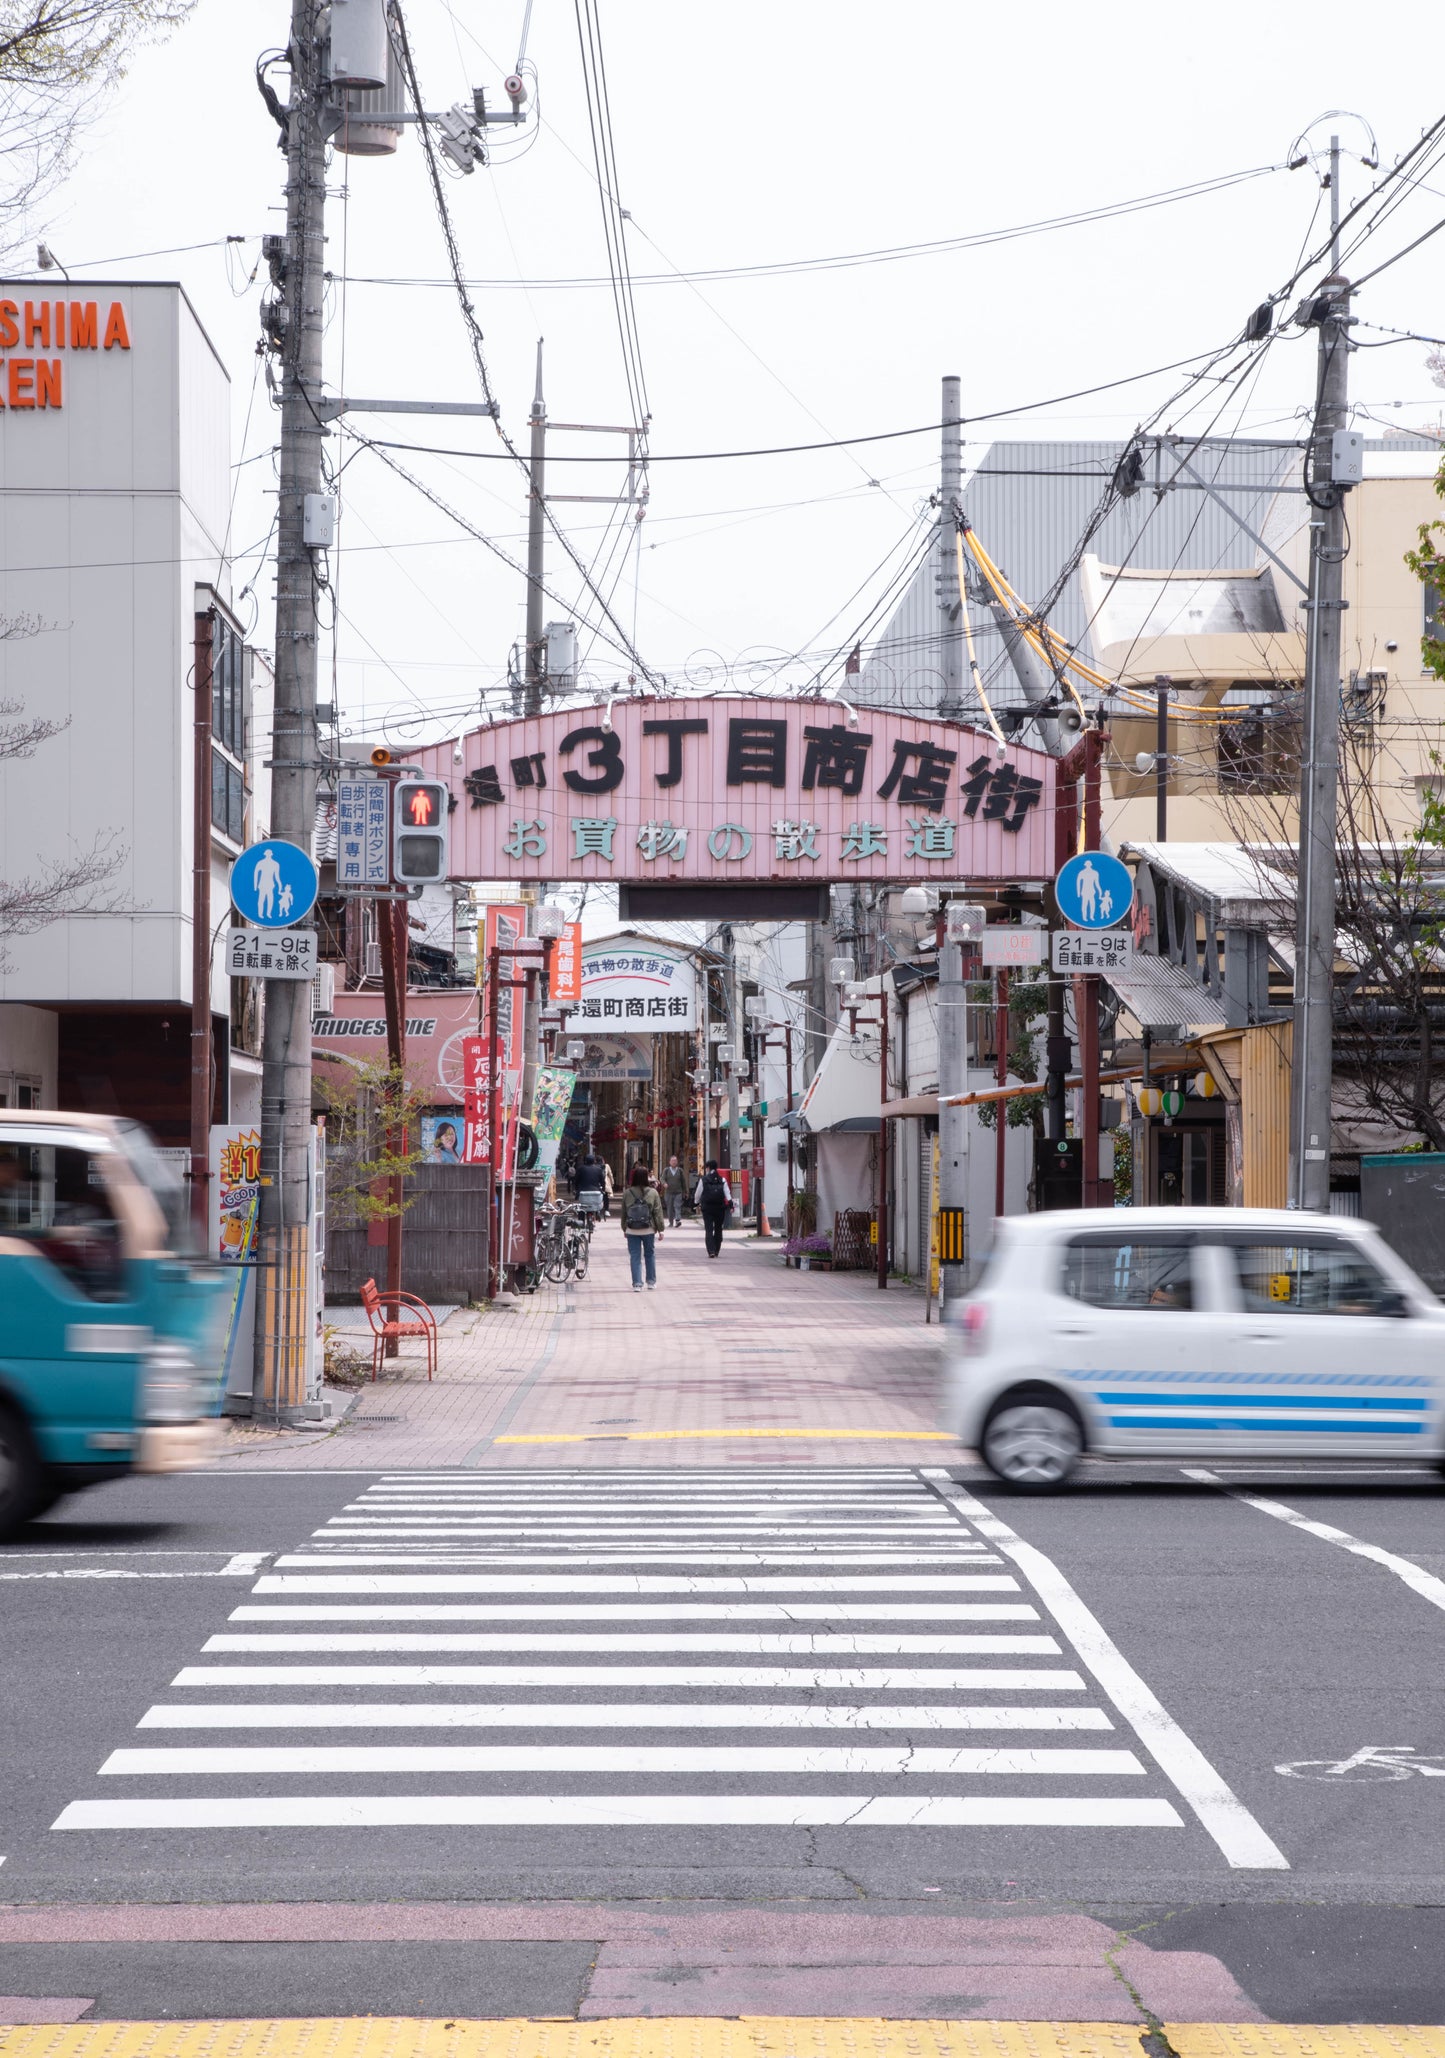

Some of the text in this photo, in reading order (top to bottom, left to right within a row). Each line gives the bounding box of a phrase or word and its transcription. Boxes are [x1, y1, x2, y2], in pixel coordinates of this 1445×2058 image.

[0, 358, 62, 409] EN
[447, 718, 1043, 832] 還町3丁目商店街
[340, 786, 352, 837] 自転車
[353, 786, 365, 837] 歩行者
[368, 785, 384, 878] 夜間押ボタン式
[345, 841, 360, 878] 専用
[503, 816, 958, 861] お買物の散歩道
[232, 952, 310, 972] 自転車を除く
[1059, 952, 1127, 967] 自転車を除く
[312, 1019, 436, 1035] RIDGESNE
